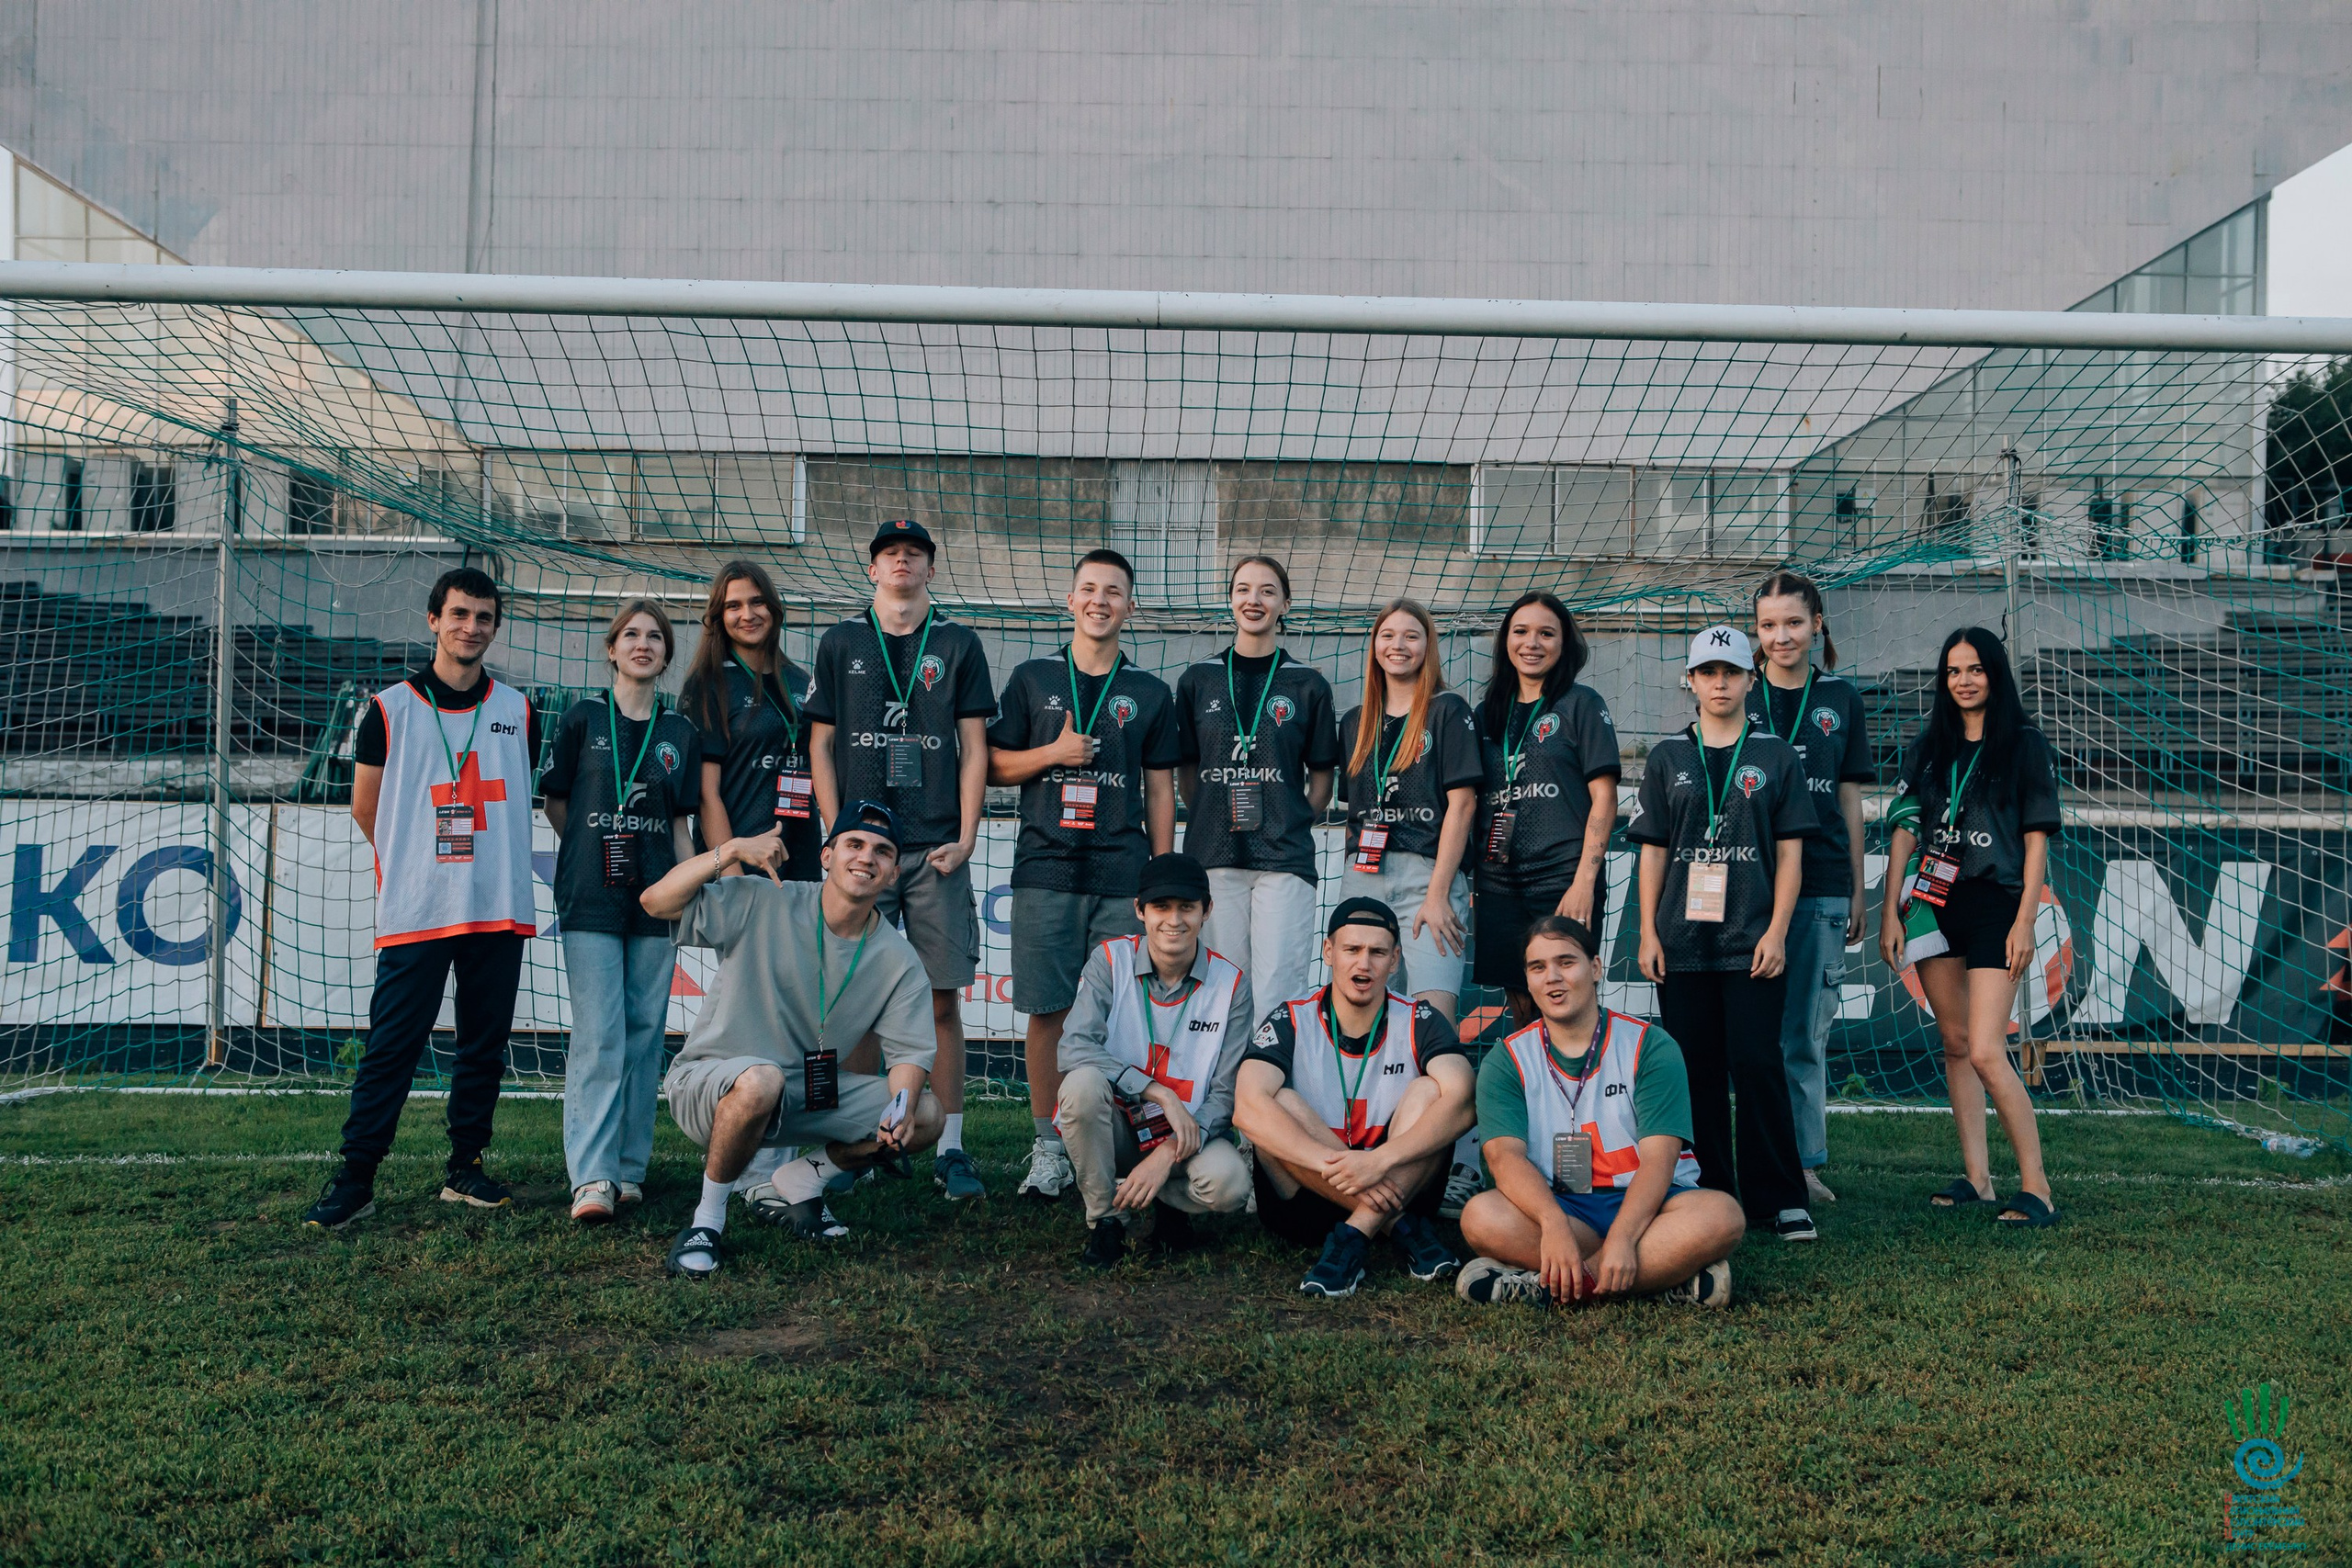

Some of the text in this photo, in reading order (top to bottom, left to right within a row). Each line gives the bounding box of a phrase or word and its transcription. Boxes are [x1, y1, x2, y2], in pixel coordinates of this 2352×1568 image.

[1710, 630, 1731, 647] NY
[851, 732, 942, 750] серко
[1188, 1020, 1220, 1032] ФНЛ
[684, 1239, 713, 1247] adidas
